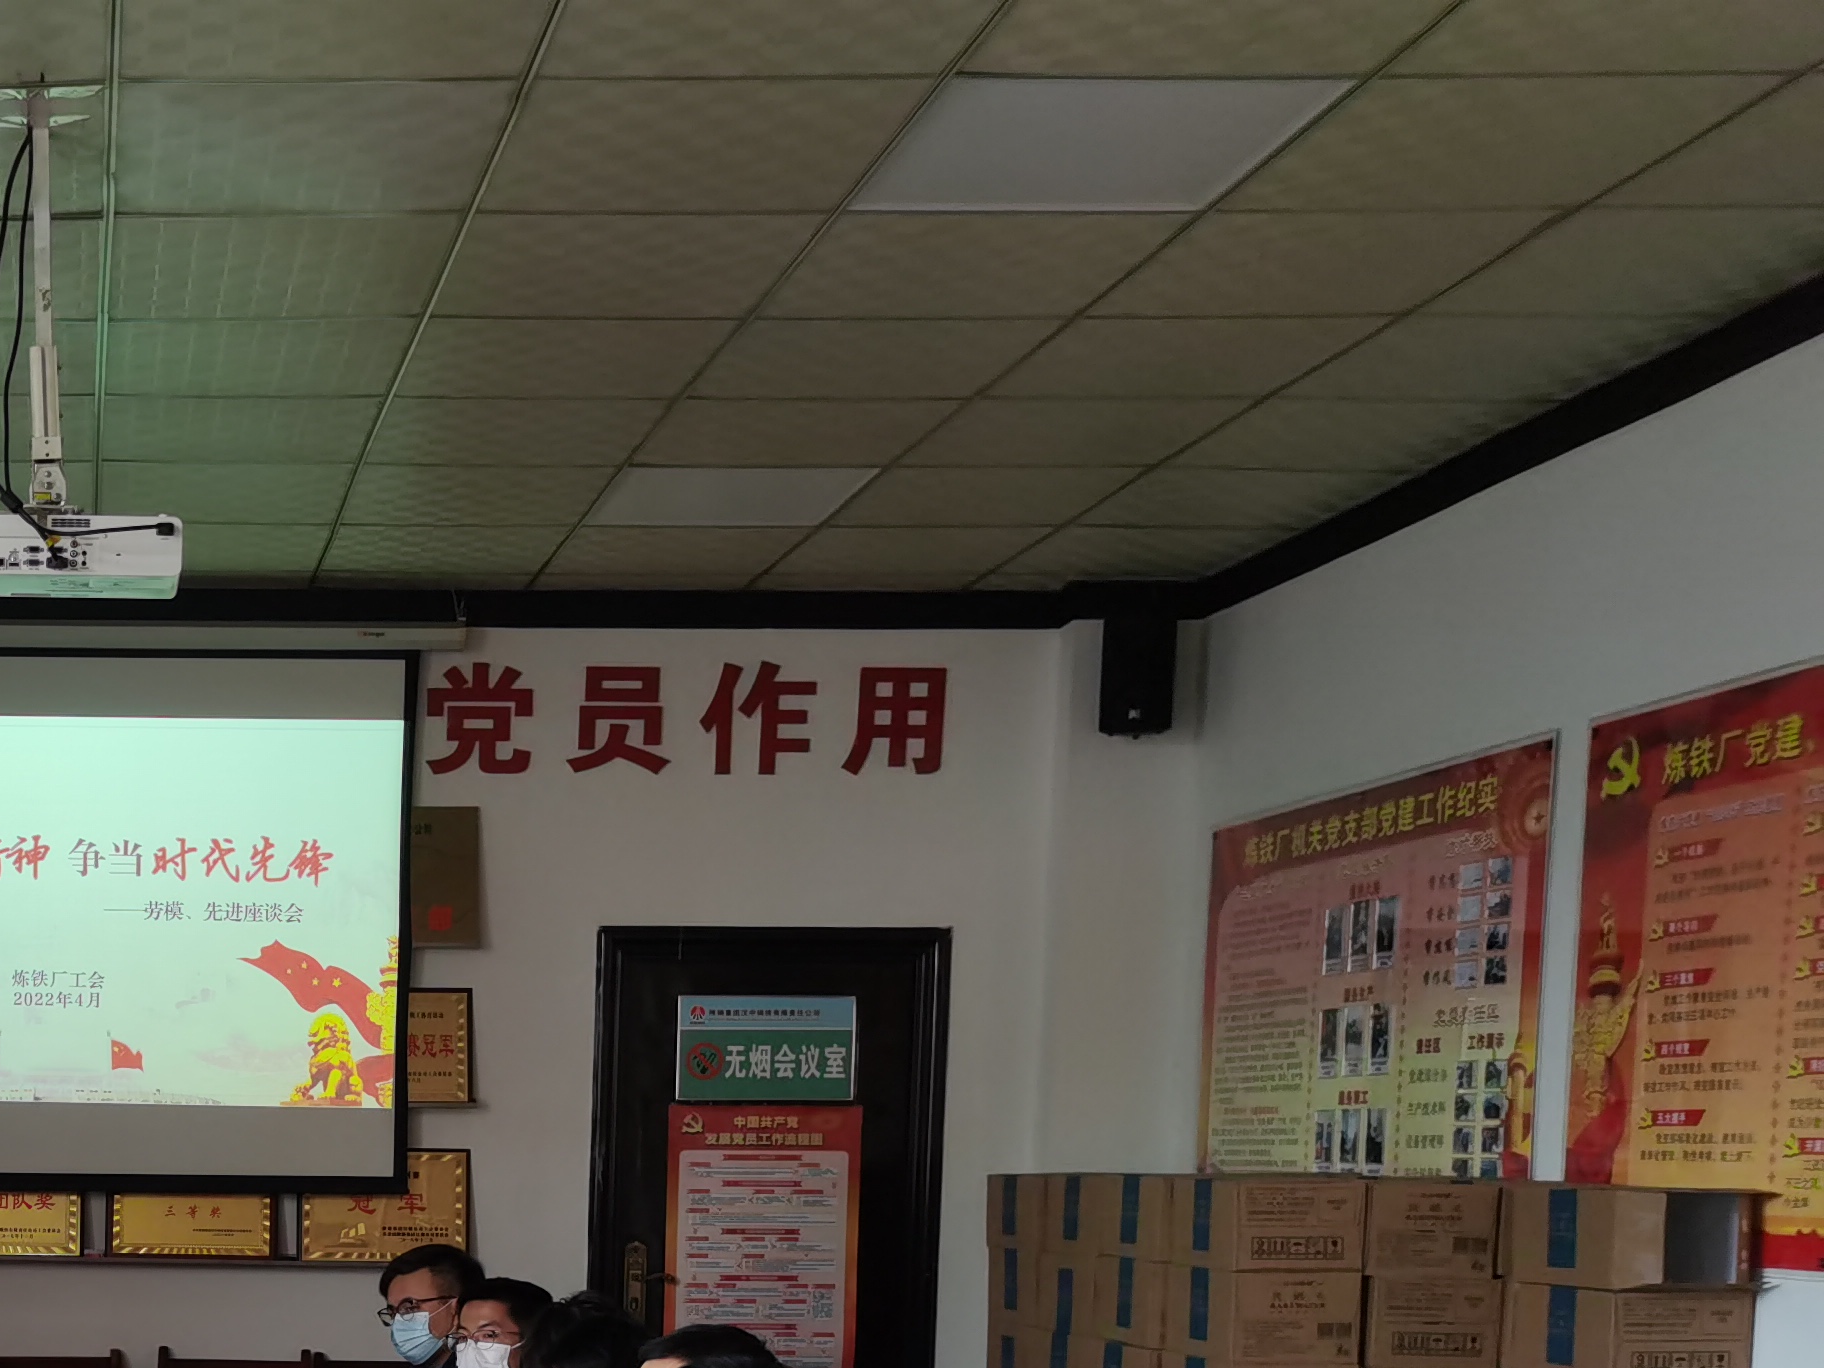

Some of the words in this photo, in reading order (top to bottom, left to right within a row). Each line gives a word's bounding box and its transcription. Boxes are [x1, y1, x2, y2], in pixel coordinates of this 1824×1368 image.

[426, 661, 948, 775] 党员作用
[68, 836, 334, 888] 争当时代先锋
[11, 968, 106, 990] 炼铁厂工会
[13, 990, 102, 1010] 2022年4月
[725, 1044, 847, 1079] 无烟会议室
[733, 1115, 800, 1129] 中国共产党
[705, 1132, 824, 1146] 发展党员工作流程图
[164, 1205, 222, 1219] 三等奖
